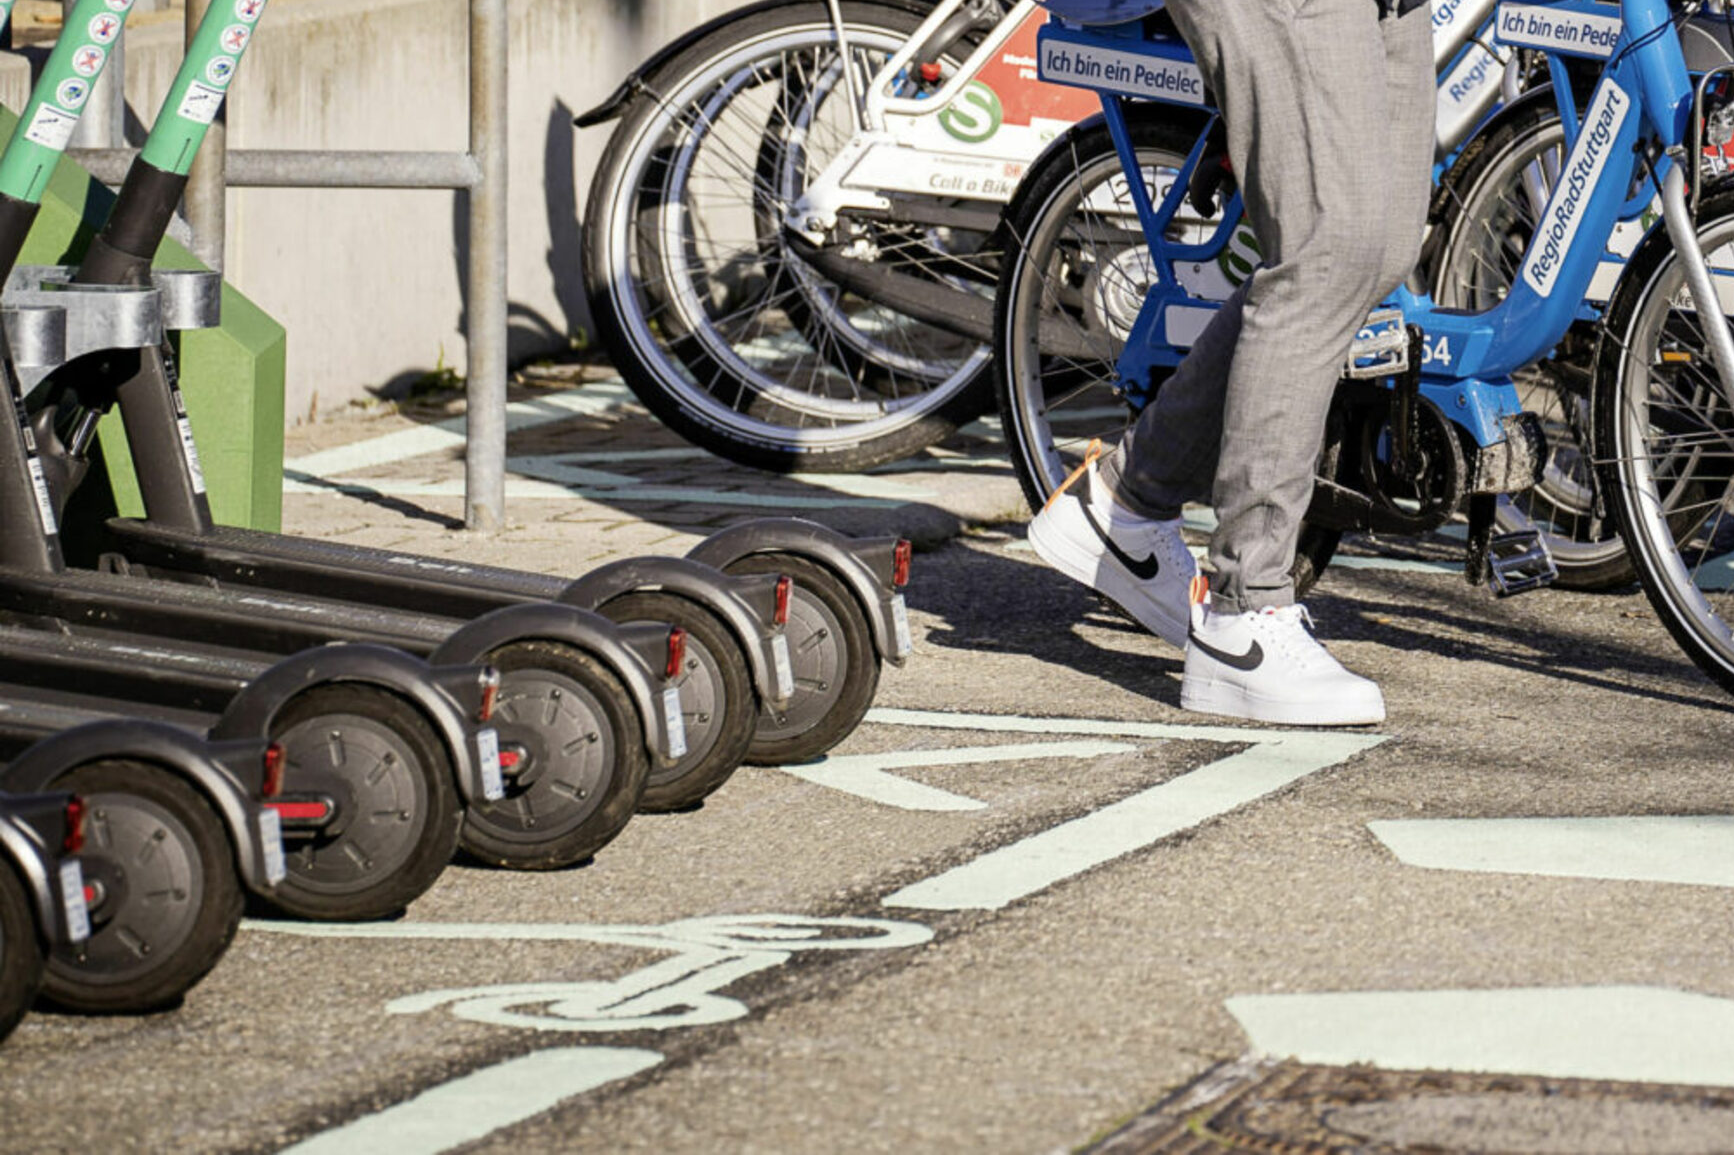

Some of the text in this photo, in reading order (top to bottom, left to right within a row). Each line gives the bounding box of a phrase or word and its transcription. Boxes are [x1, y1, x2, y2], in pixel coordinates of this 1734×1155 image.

[1502, 11, 1620, 48] Ich bin ein Pede
[1047, 49, 1071, 73] Ich
[1075, 52, 1100, 78] bin
[1104, 60, 1131, 84] ein
[1134, 64, 1200, 95] Pedelec
[982, 178, 1013, 196] Bik
[1530, 89, 1621, 285] RegioRadStuttgart
